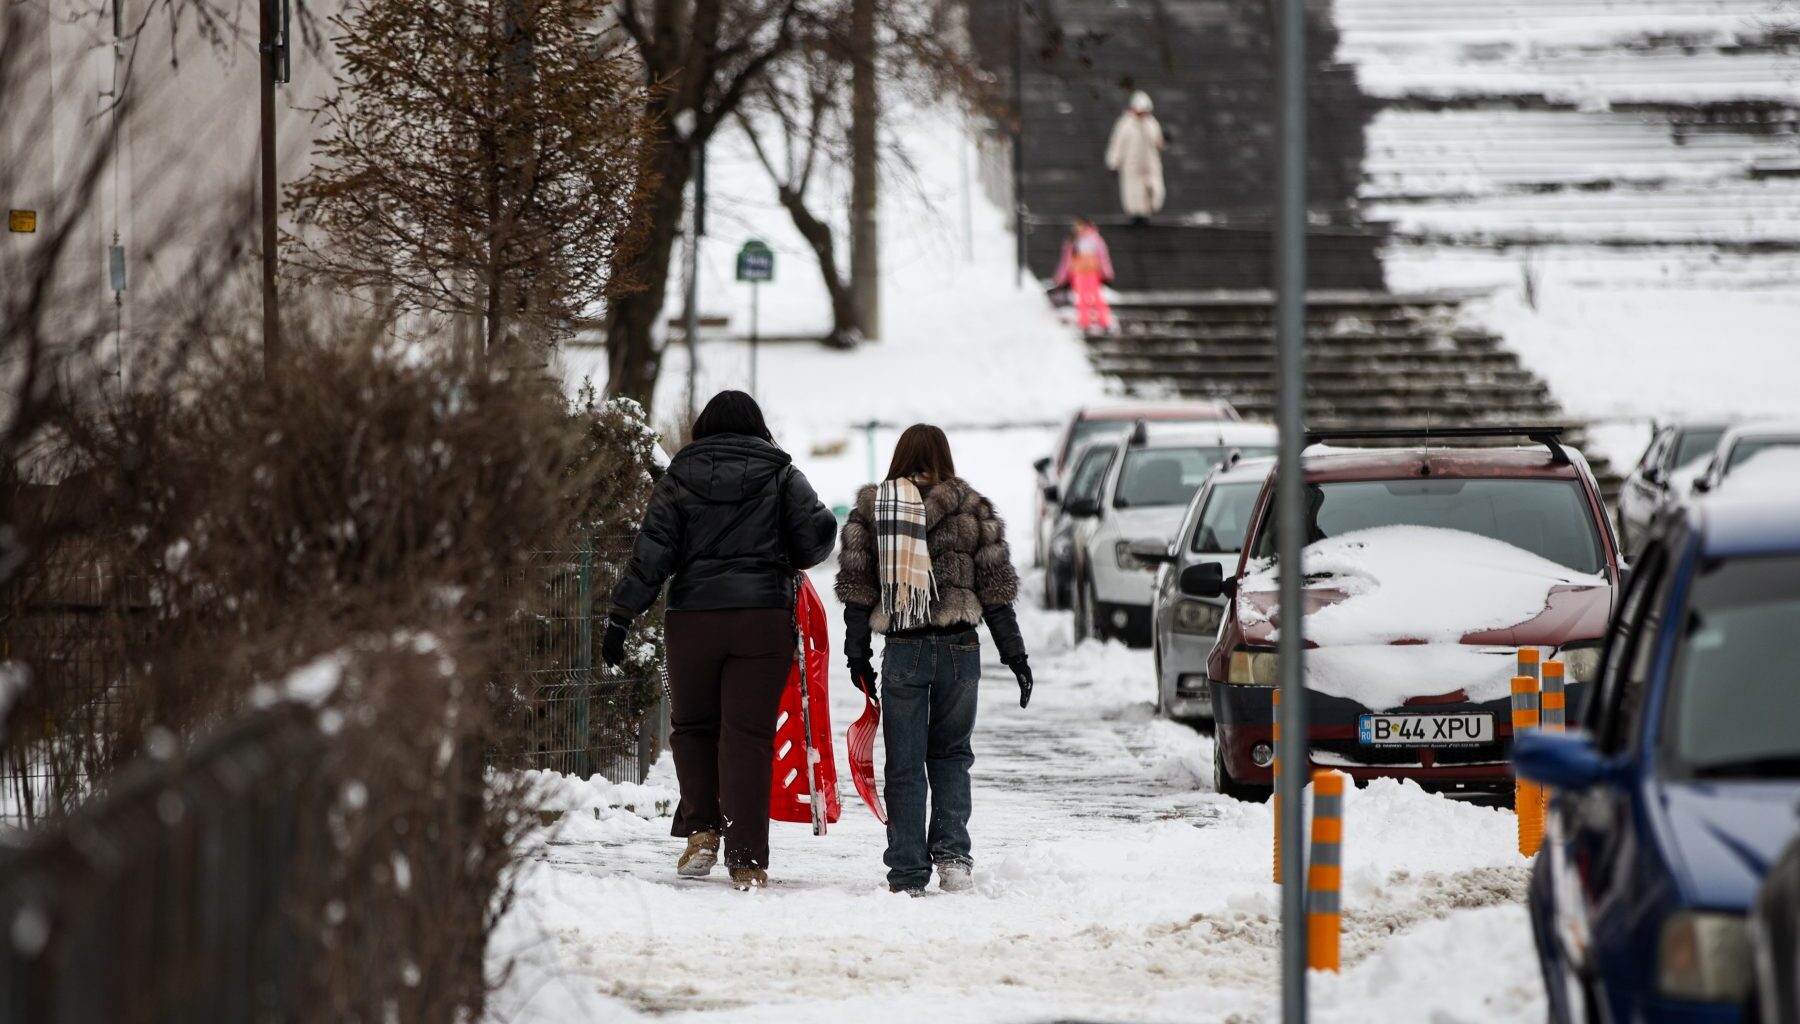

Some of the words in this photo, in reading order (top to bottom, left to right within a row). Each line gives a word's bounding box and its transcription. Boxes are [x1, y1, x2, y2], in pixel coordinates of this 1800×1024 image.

[1361, 731, 1371, 740] RO
[1375, 719, 1391, 739] B
[1399, 718, 1425, 739] 44
[1432, 717, 1481, 739] XPU
